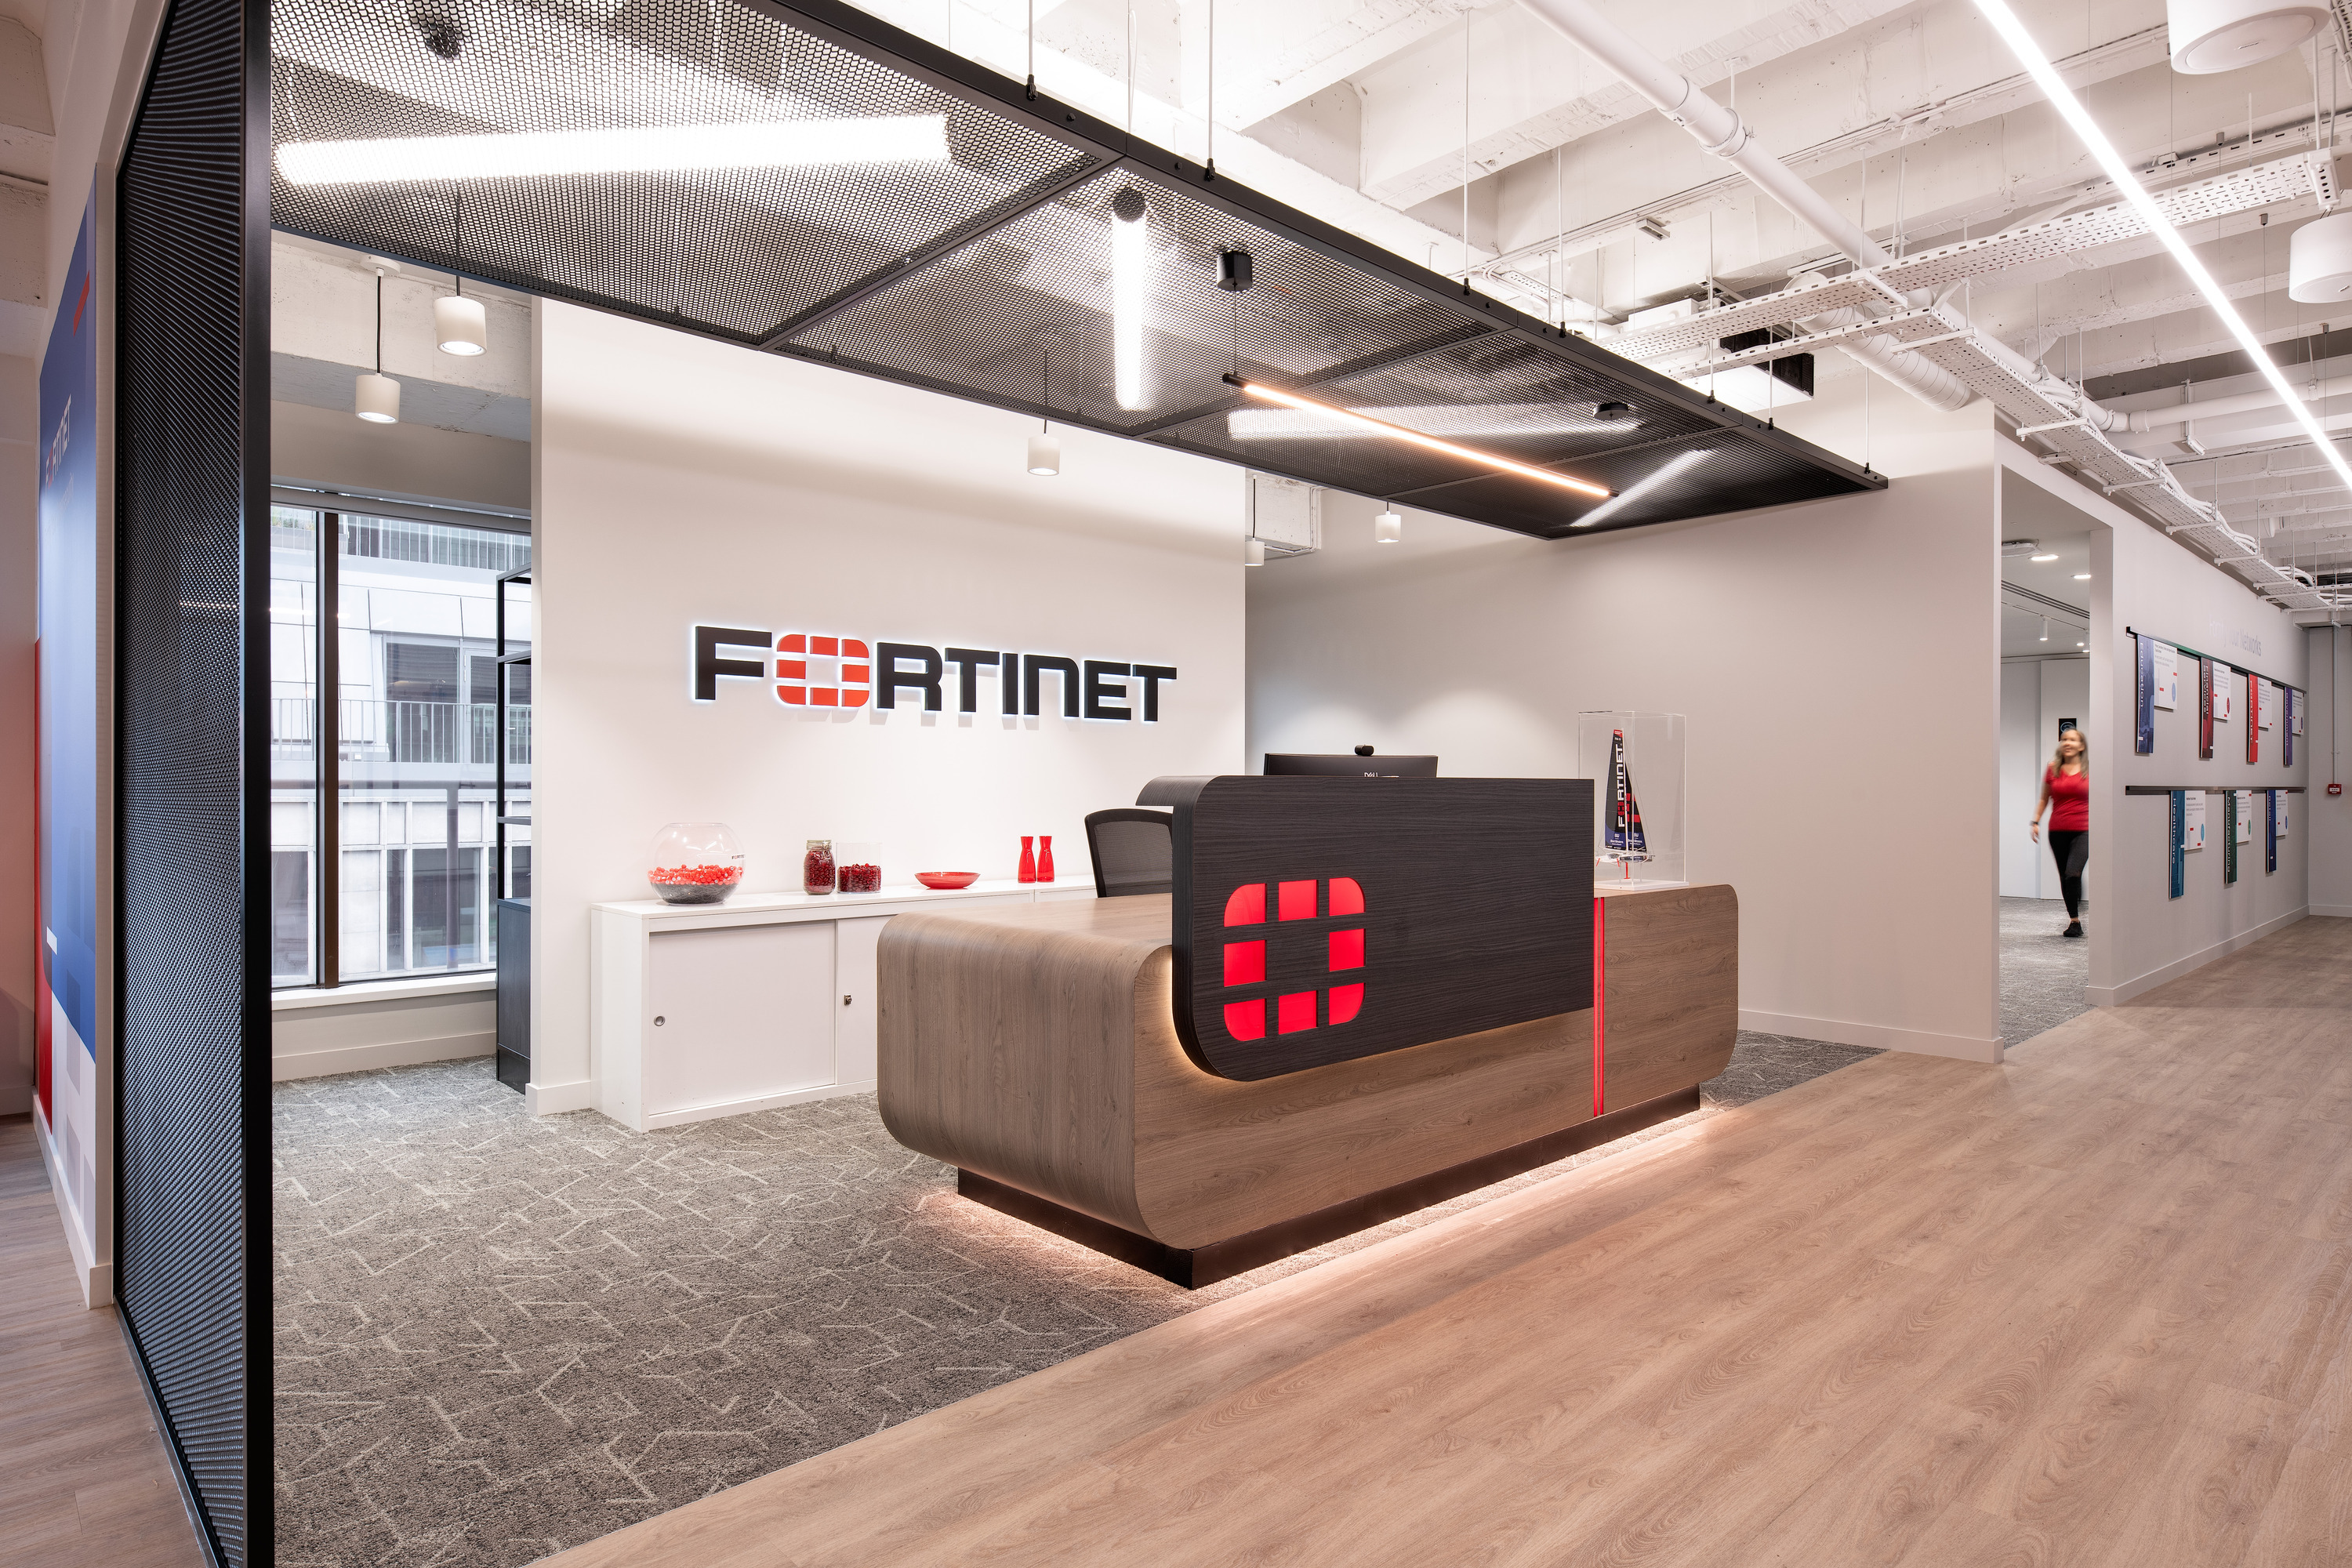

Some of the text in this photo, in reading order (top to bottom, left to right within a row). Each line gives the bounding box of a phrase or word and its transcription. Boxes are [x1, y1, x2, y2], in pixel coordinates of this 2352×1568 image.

[45, 393, 72, 495] FORTINET
[695, 626, 1177, 722] FORTINET
[2240, 627, 2262, 657] Networks
[1615, 743, 1624, 828] FORTINET
